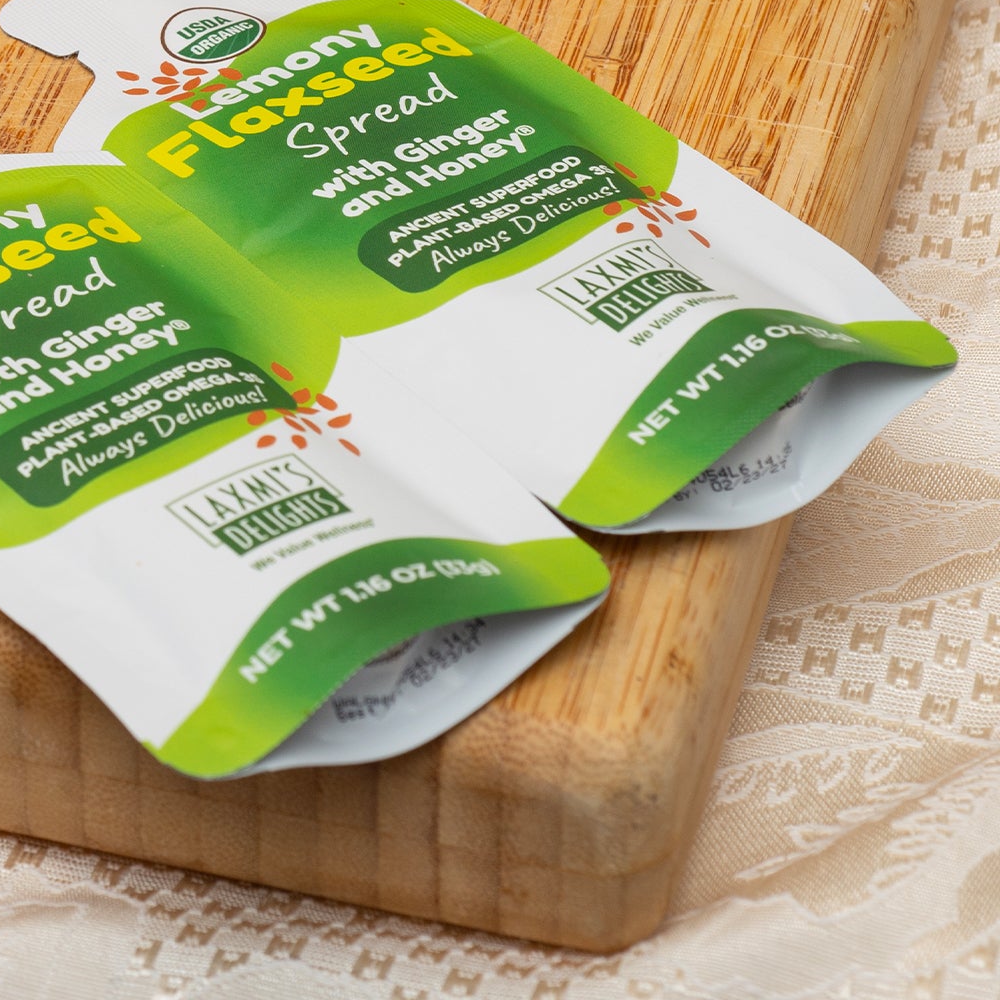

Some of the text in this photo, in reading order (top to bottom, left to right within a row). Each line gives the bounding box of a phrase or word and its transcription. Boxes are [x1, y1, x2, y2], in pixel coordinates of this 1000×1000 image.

[169, 24, 382, 121] Lemony
[176, 16, 232, 40] USDA
[190, 21, 254, 56] ORGANIC
[147, 27, 473, 179] Flaxseed
[286, 71, 459, 159] Spread
[312, 108, 510, 199] with Ginger
[341, 176, 413, 218] and
[387, 202, 521, 268] PLANT-BASED
[519, 172, 593, 206] OMEGA
[388, 155, 582, 244] ANCIENT SUPERFOOD
[430, 176, 622, 273] Always Delicious!
[555, 244, 675, 306] LAXMI'S
[599, 270, 704, 325] DELIGHTS
[40, 301, 166, 359] Ginger
[628, 329, 654, 348] We
[649, 304, 688, 331] Value
[16, 399, 163, 478] PLANT-BASED
[162, 370, 242, 403] OMEGA
[20, 356, 233, 451] ANCIENT SUPERFOOD
[627, 397, 681, 446] NET
[675, 362, 725, 401] WT
[718, 333, 769, 369] 1.16
[764, 324, 805, 340] OZ
[60, 384, 269, 487] Always Delicious!
[183, 462, 314, 528] LAXMI'S
[223, 490, 341, 551] DELIGHTS
[238, 626, 294, 684] NET
[290, 593, 343, 632] WT
[338, 574, 393, 604] 1.16
[390, 562, 437, 584] OZ
